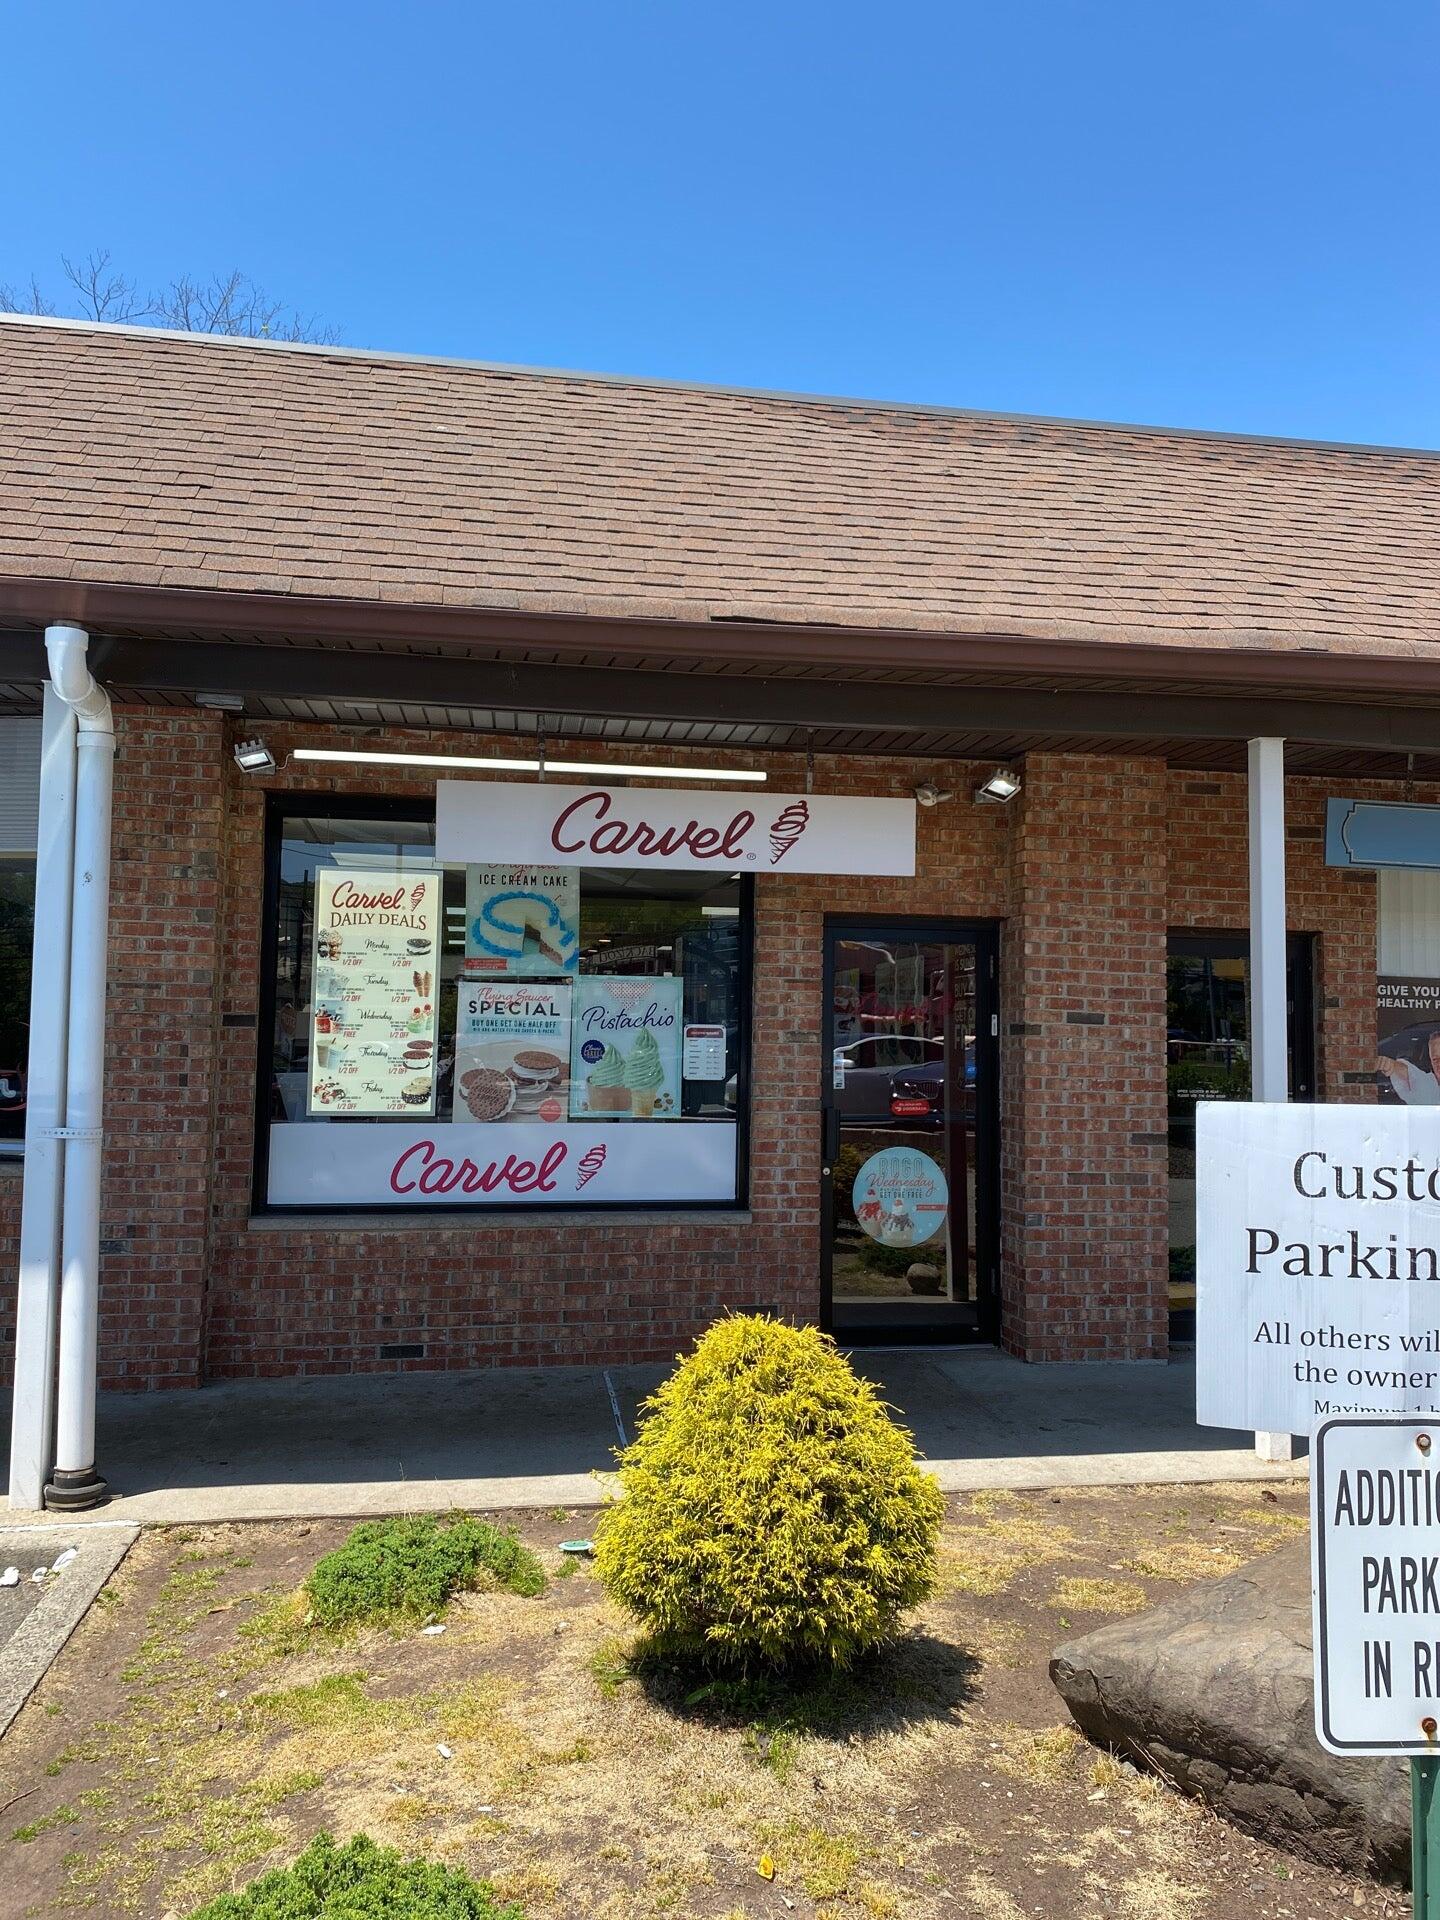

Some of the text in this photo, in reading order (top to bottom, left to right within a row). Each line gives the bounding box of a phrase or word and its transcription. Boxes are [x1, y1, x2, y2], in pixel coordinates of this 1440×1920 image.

[551, 791, 755, 859] Carvel
[479, 874, 568, 887] ICE CREAM CAKE
[332, 881, 405, 909] Carvel
[330, 912, 427, 930] DAILY DEALS
[364, 939, 390, 952] Monday
[363, 973, 389, 986] Tuesday
[1377, 984, 1440, 997] GIVE YOU
[469, 1000, 560, 1017] SPECIAL
[478, 987, 553, 1009] Flying Saucer
[1377, 997, 1431, 1009] HEALTHY
[358, 1008, 392, 1021] Wednesday
[581, 1002, 674, 1032] Pistachio
[360, 1046, 388, 1057] Thursday
[361, 1080, 384, 1093] Friday
[390, 1140, 568, 1194] Carvel
[880, 1157, 923, 1178] BOGO
[865, 1172, 934, 1198] Wednesday
[1245, 1227, 1440, 1281] Parkin
[1253, 1321, 1291, 1345] All
[1300, 1325, 1390, 1351] others
[1293, 1360, 1437, 1389] the owner
[1334, 1469, 1440, 1526] ADDITI
[1362, 1556, 1440, 1614] PARK
[1364, 1641, 1440, 1698] IN R
